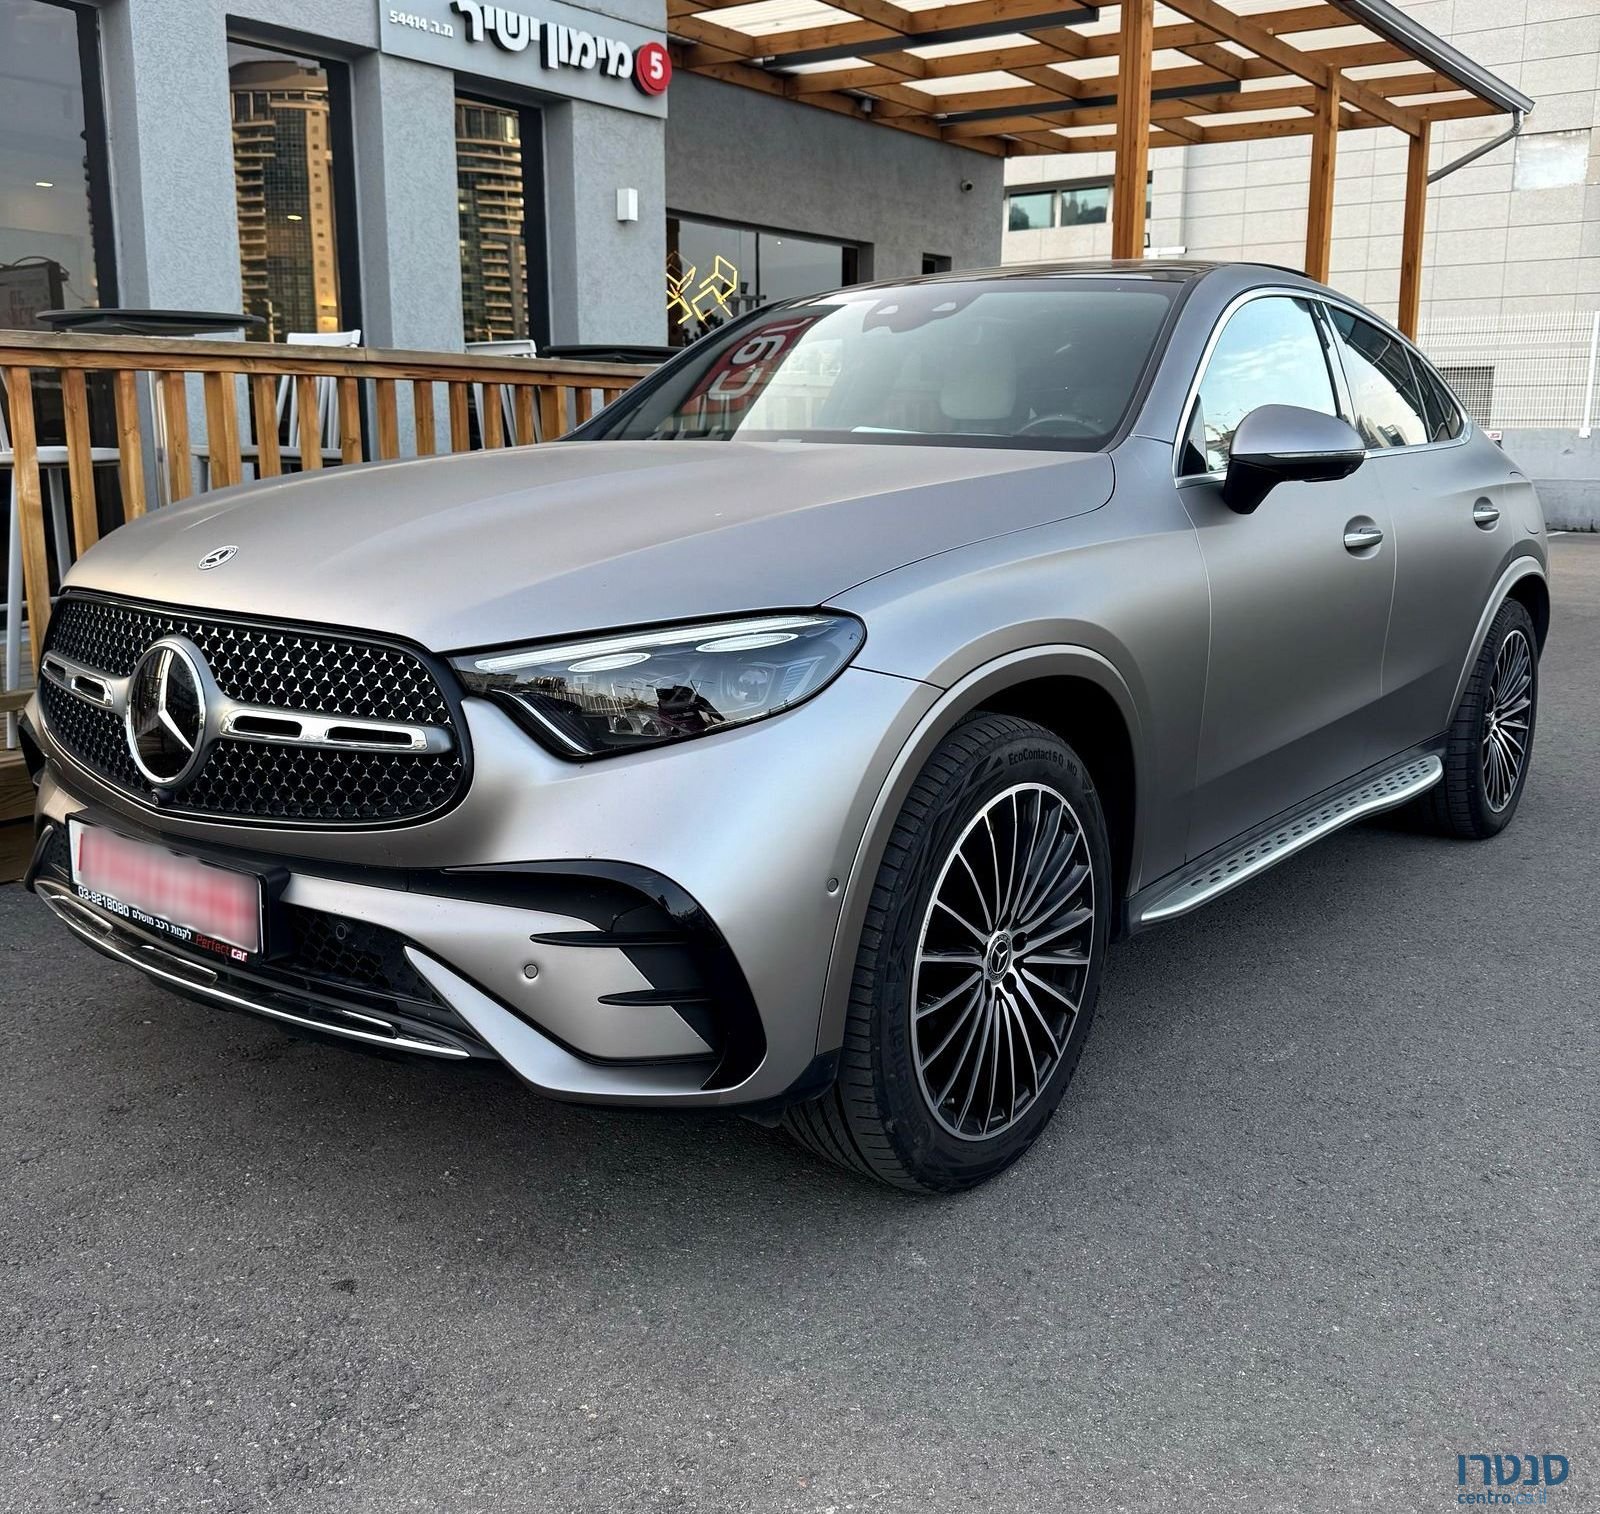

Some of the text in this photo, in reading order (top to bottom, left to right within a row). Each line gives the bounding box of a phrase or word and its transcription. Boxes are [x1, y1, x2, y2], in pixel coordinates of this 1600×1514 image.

[389, 9, 428, 31] 54414
[455, 0, 664, 79] 5 מימון ישיר
[132, 909, 154, 926] מושלם
[155, 918, 169, 931] רכב
[195, 934, 230, 955] Perfect
[231, 948, 248, 962] car
